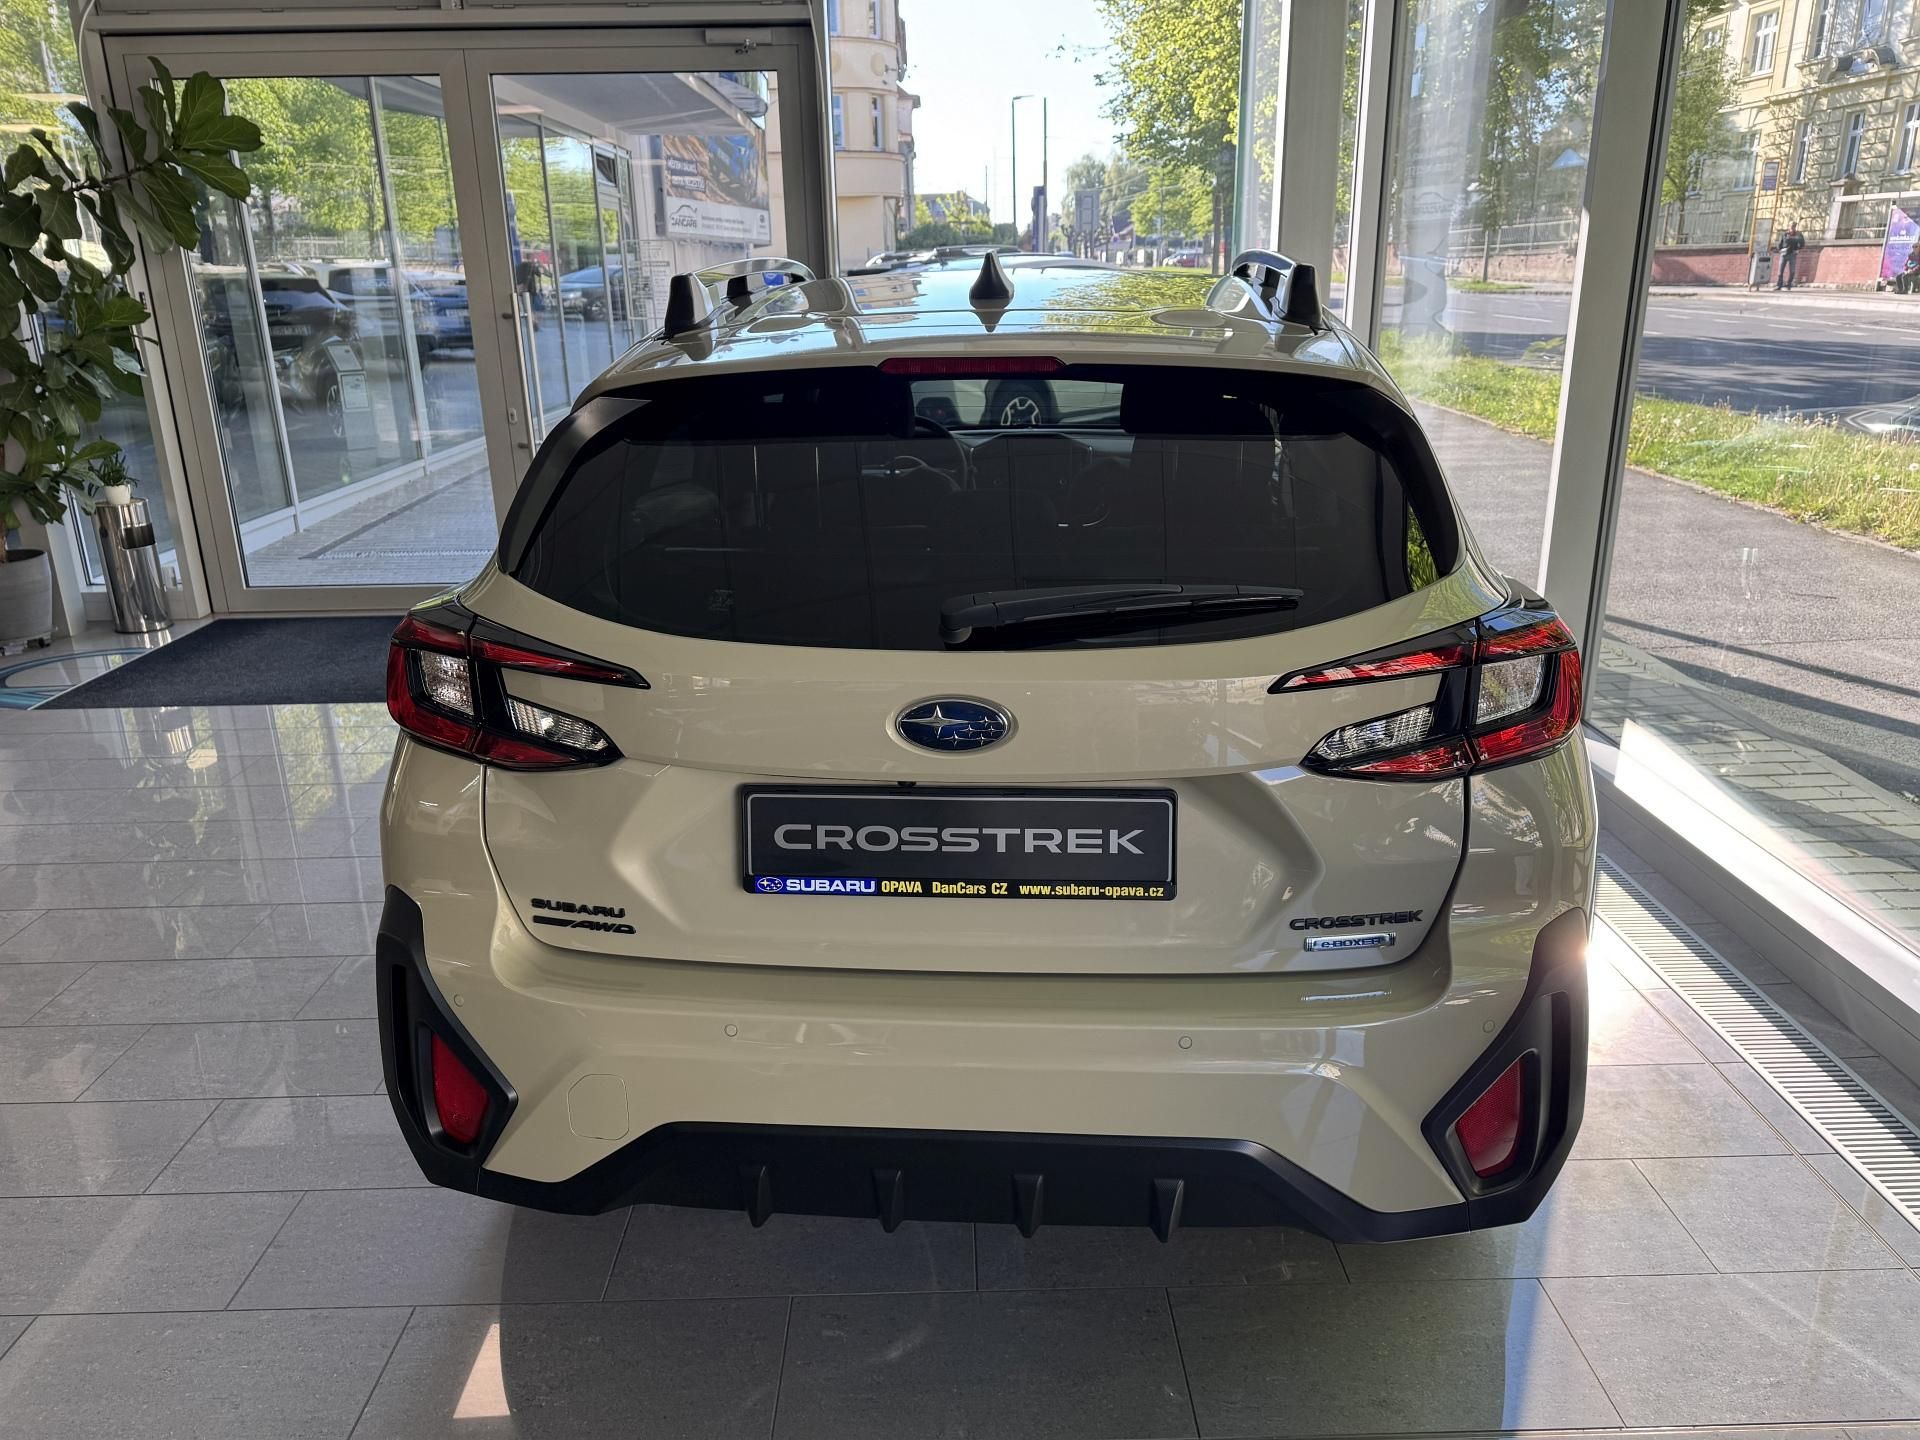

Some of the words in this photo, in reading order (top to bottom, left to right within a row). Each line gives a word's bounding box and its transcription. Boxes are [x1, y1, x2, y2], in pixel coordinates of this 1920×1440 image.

[773, 823, 1145, 855] CROSSTREK
[786, 879, 876, 893] SUBARU
[881, 880, 923, 893] OPAVA
[932, 881, 987, 895] DanCars
[991, 882, 1008, 895] CZ
[1019, 883, 1164, 898] www.subaru-opava.cz
[531, 898, 625, 918] SUBARU
[570, 920, 637, 934] AWD
[1289, 909, 1423, 930] CROSSTREK
[1321, 937, 1382, 948] e-BOXER
